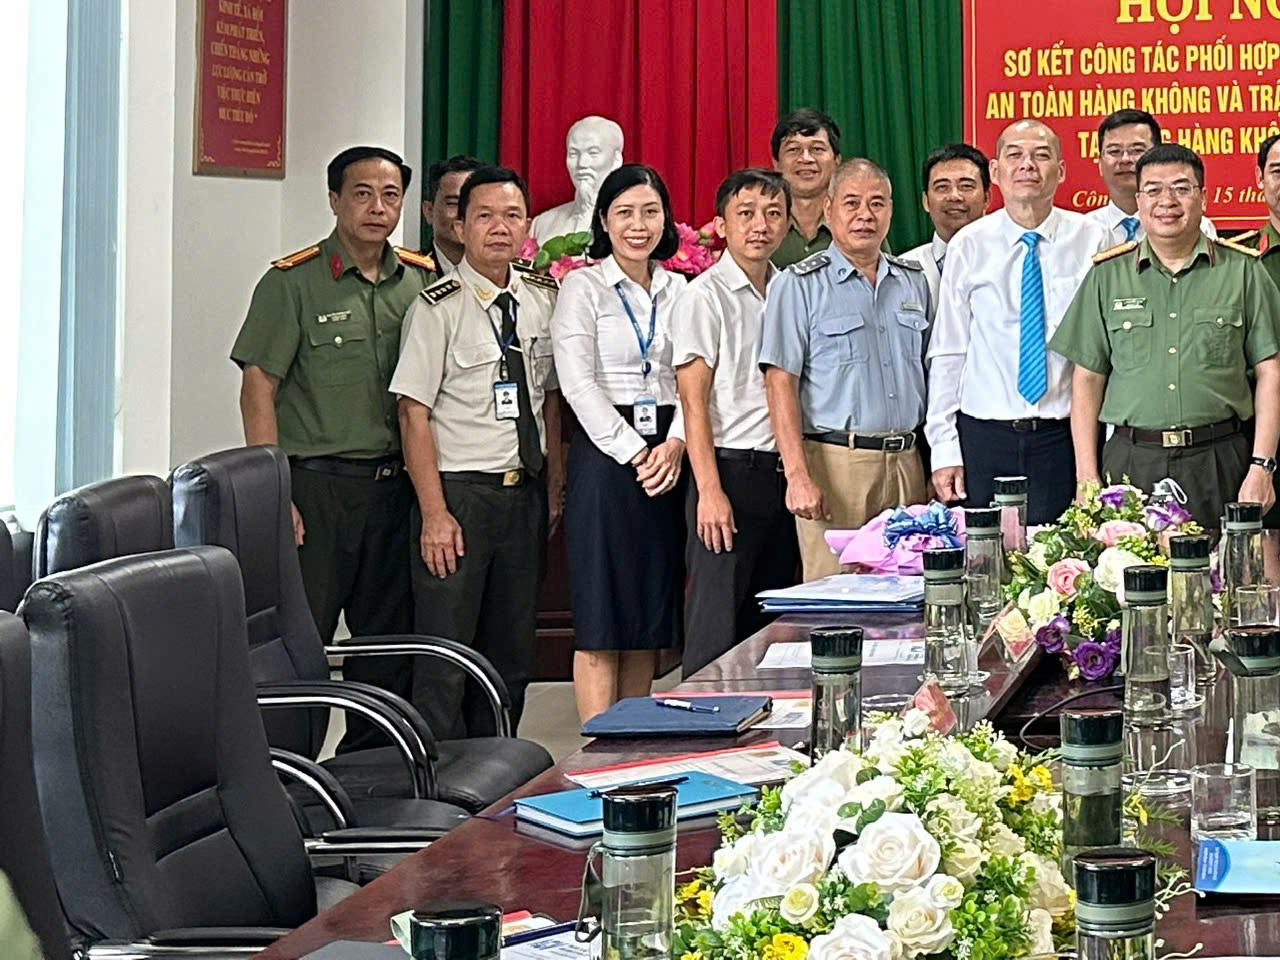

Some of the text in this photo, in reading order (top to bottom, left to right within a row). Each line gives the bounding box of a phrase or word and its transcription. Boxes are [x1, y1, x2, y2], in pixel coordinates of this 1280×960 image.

[1003, 46, 1032, 78] SƠ
[1037, 40, 1075, 77] KẾT
[1079, 42, 1136, 75] CÔNG
[1141, 41, 1180, 73] TÁC
[1186, 34, 1233, 72] PHỐI
[1239, 39, 1280, 76] HỢP
[985, 92, 1015, 120] AN
[1020, 84, 1073, 119] TOÀN
[1079, 83, 1136, 117] HÀNG
[1141, 81, 1212, 114] KHÔNG
[1216, 80, 1244, 113] VÀ
[1078, 131, 1100, 164] TẠ
[1177, 122, 1234, 155] HÀNG
[1072, 190, 1109, 207] Côn
[1213, 186, 1232, 203] 15
